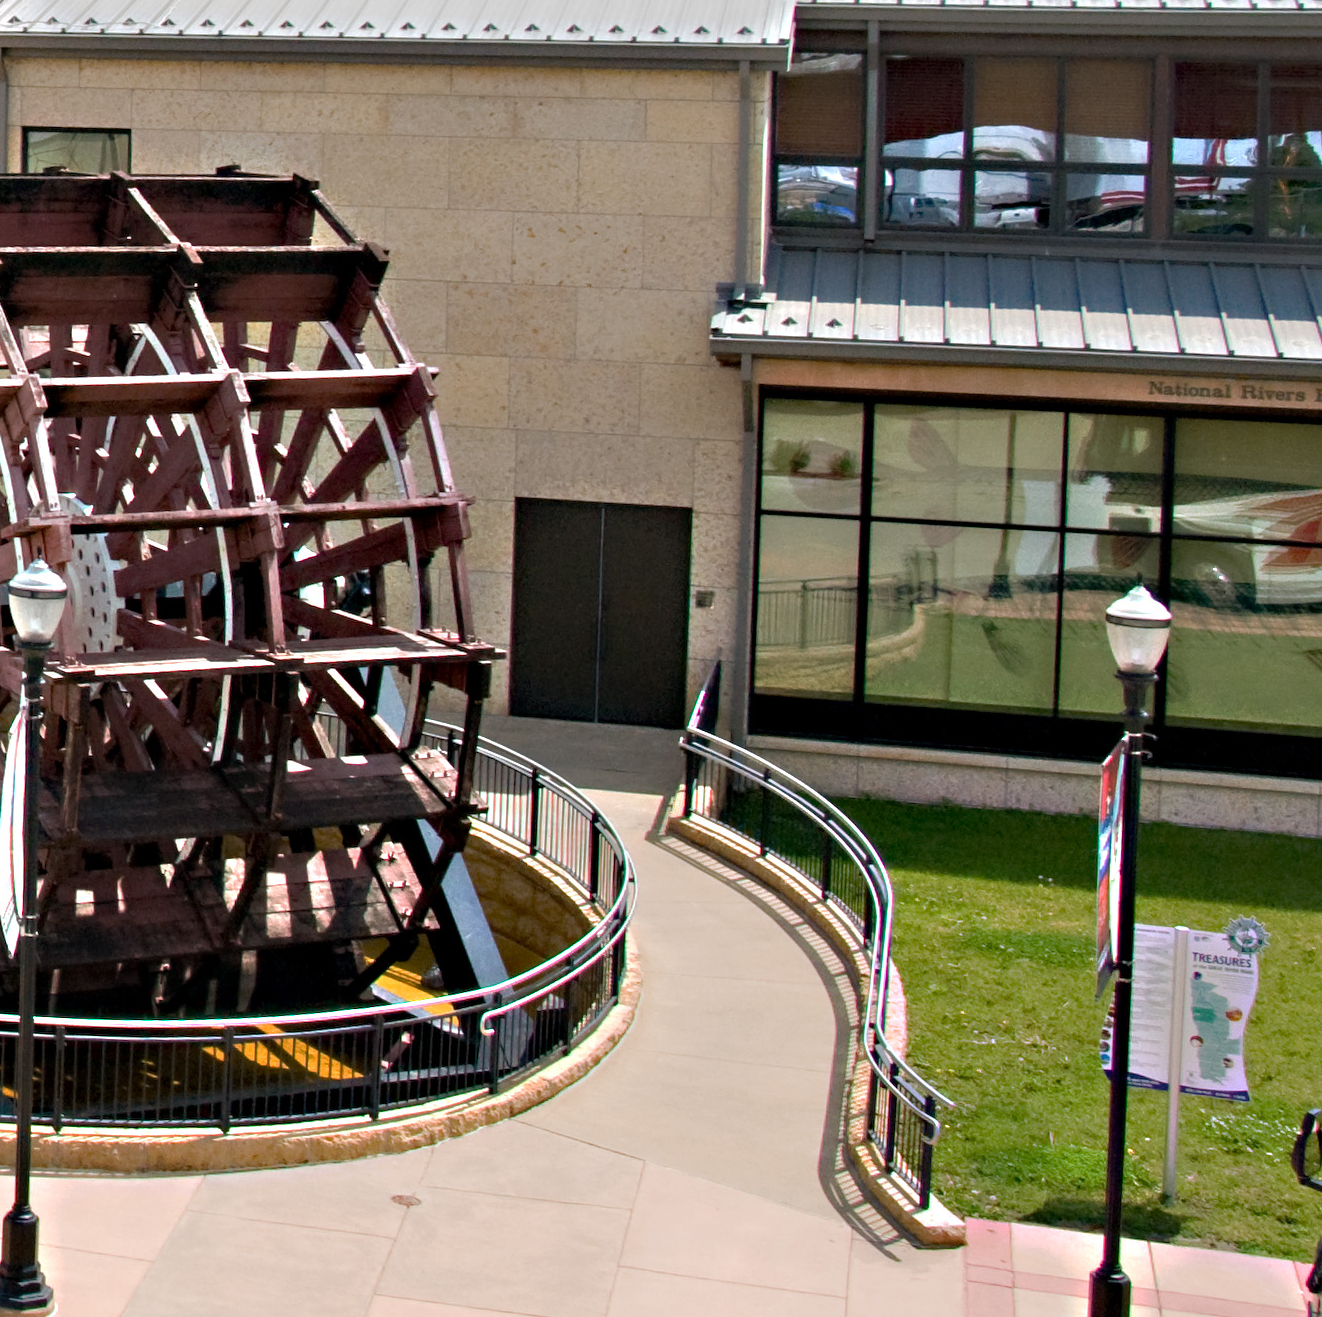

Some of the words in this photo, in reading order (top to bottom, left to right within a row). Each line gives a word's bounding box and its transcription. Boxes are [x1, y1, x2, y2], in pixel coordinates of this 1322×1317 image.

[1147, 381, 1232, 399] National
[1241, 384, 1306, 402] Rivers
[1192, 952, 1252, 968] TREASURES
